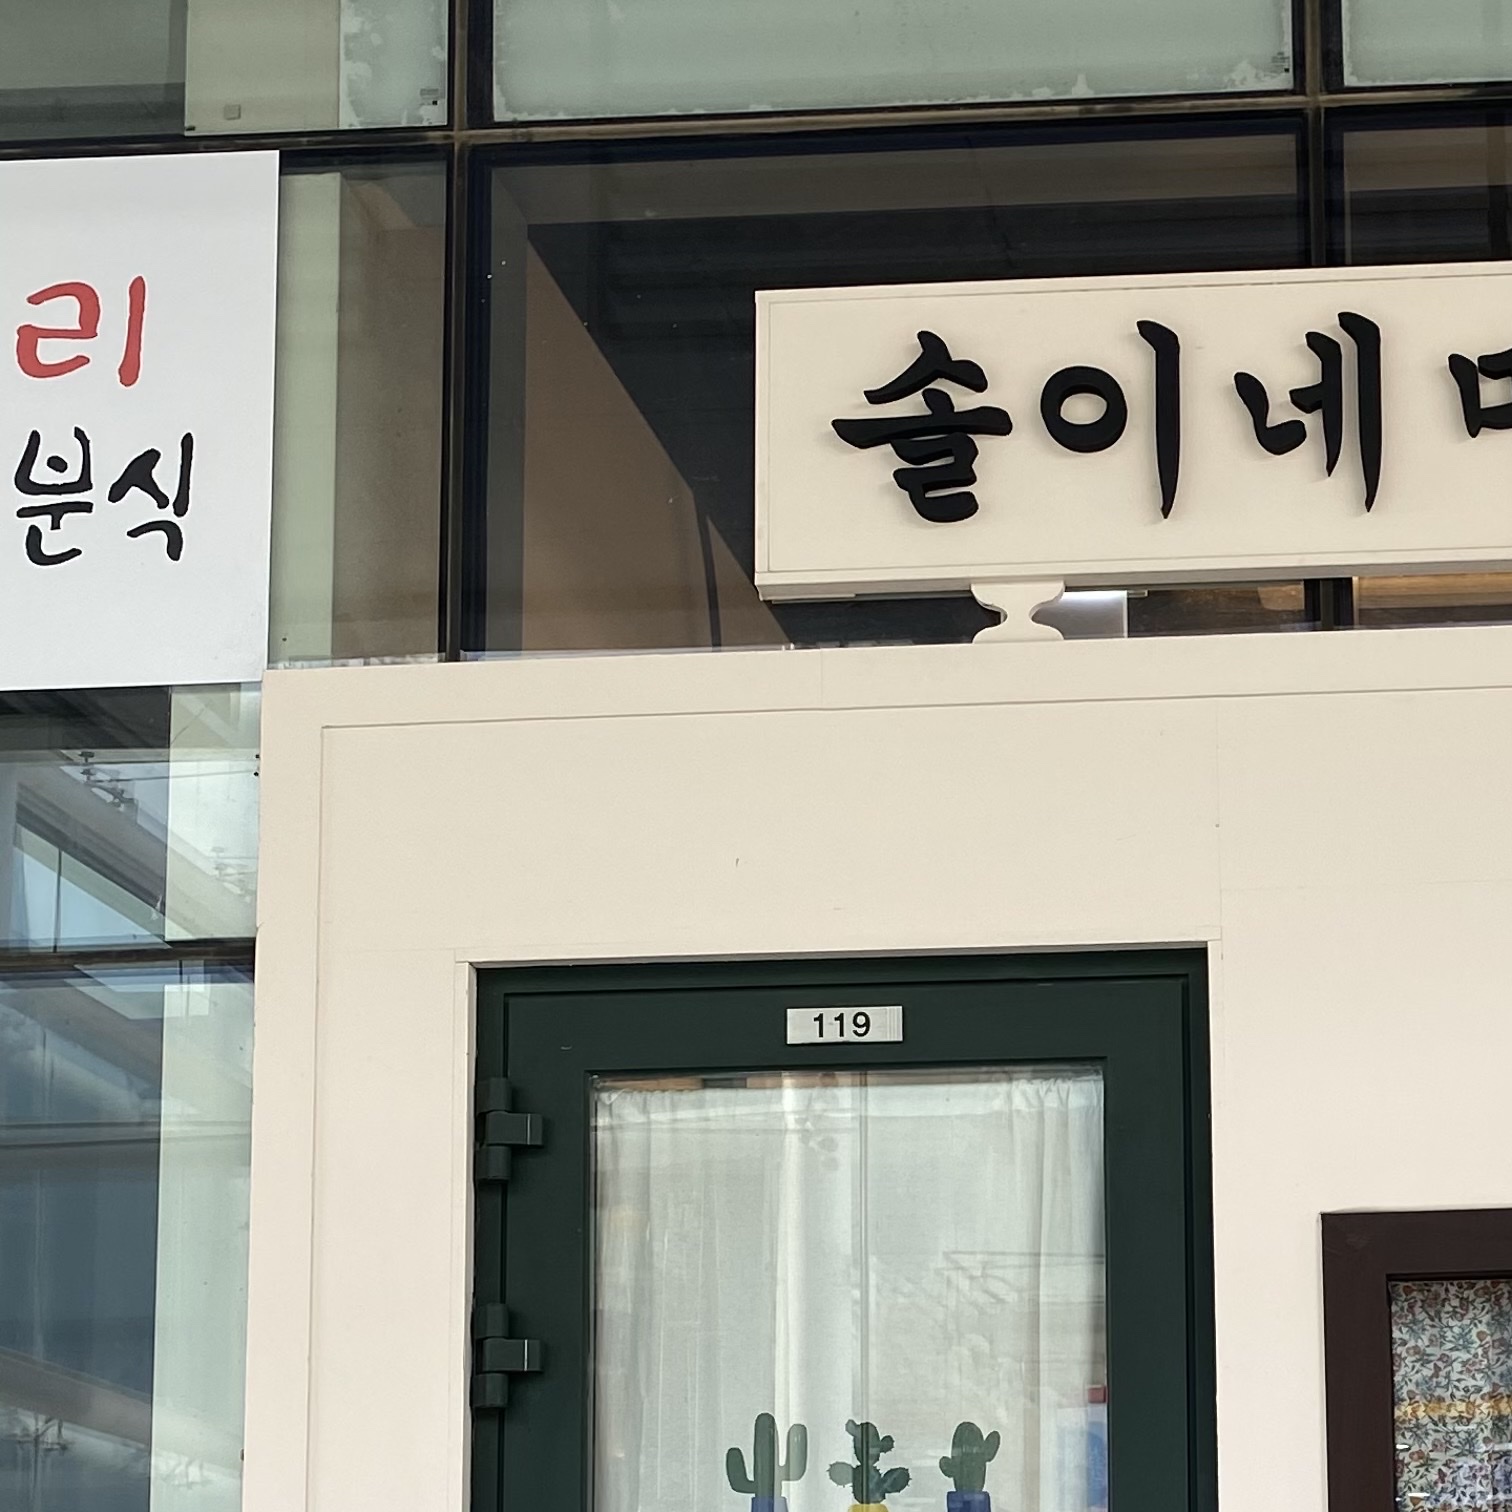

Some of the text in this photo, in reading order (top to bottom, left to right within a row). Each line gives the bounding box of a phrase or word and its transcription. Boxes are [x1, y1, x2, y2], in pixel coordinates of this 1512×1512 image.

[16, 275, 147, 388] 리
[14, 426, 194, 566] 분식
[813, 1011, 871, 1038] 119
